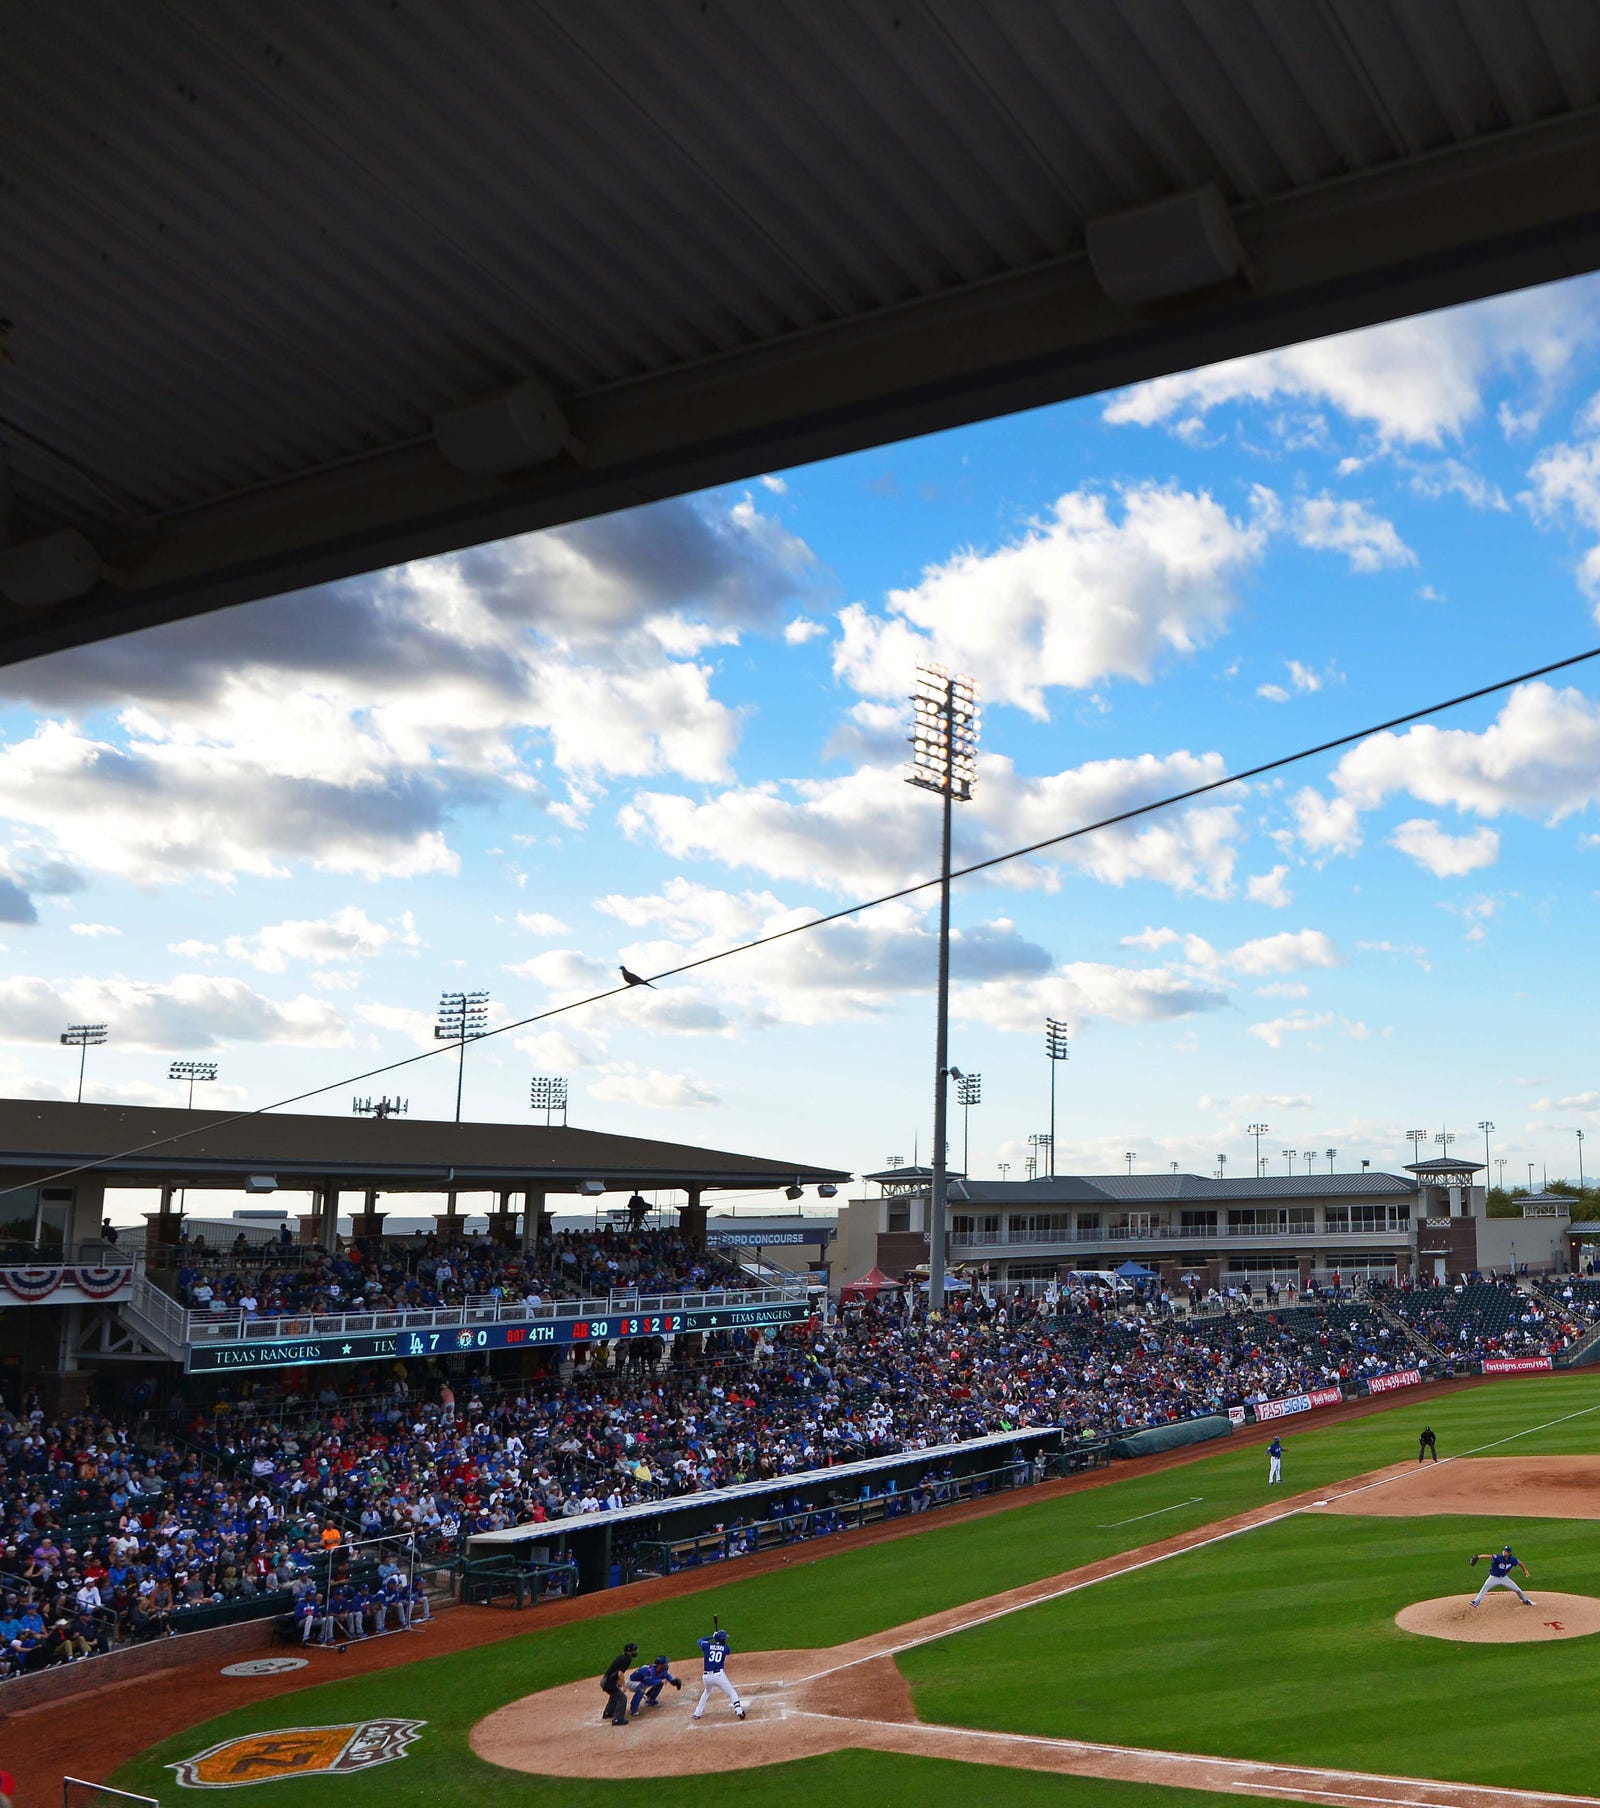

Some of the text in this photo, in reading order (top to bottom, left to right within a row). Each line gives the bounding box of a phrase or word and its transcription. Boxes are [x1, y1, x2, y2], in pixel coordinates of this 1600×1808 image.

[748, 1234, 804, 1244] CONCOURSE
[731, 1313, 755, 1323] TEXAS
[756, 1310, 792, 1321] RANGERS
[507, 1327, 554, 1343] BOT 4TH
[572, 1322, 608, 1338] AB 30
[409, 1333, 440, 1354] LA 7
[477, 1331, 487, 1346] 0
[215, 1341, 397, 1364] TEXAS RANGERS TEX
[1486, 1362, 1548, 1372] fastsigns.com/194
[1372, 1372, 1419, 1393] 602-439-4242
[1263, 1392, 1338, 1419] FASTSIGNS Bell Road
[708, 1651, 722, 1662] 30
